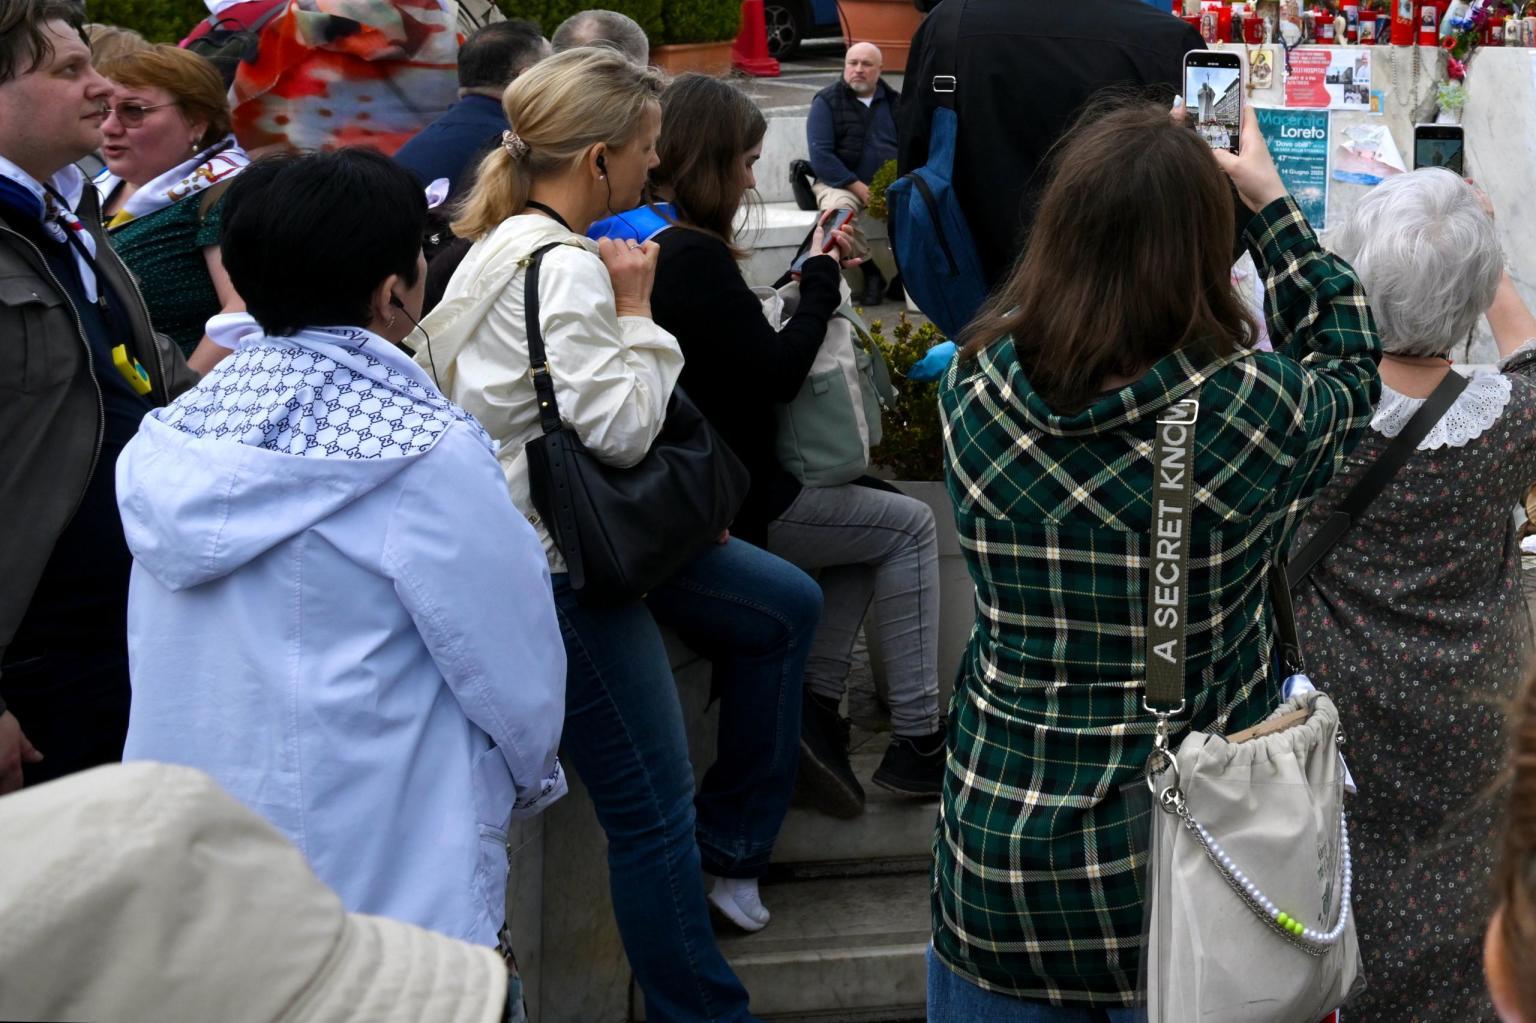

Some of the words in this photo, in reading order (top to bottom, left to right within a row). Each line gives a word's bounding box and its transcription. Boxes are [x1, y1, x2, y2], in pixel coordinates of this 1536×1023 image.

[1258, 111, 1326, 127] Macerata
[1281, 125, 1325, 139] Loreto
[1153, 499, 1182, 629] SECRET
[1153, 638, 1178, 664] A
